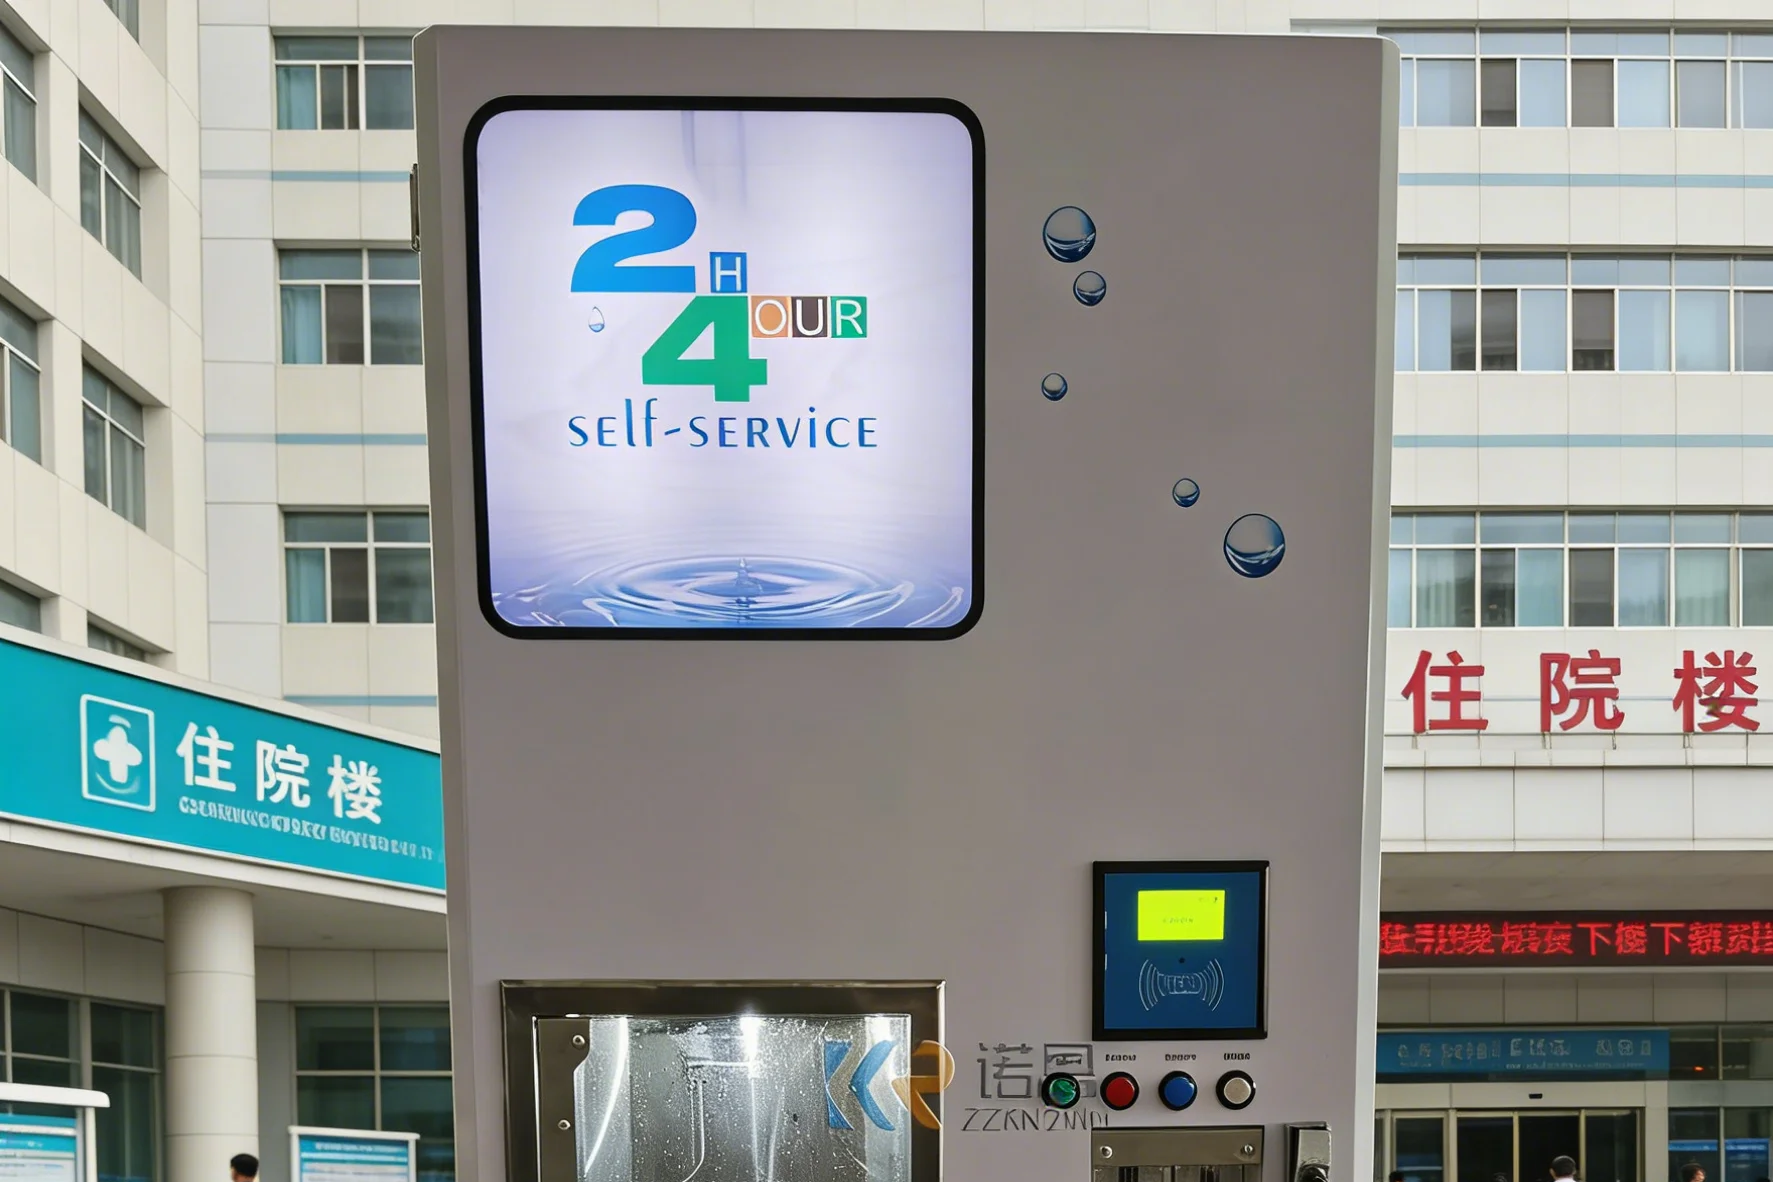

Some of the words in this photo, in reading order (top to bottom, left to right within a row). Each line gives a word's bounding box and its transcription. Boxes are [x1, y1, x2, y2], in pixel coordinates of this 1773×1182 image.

[1401, 649, 1760, 733] 住院楼
[176, 721, 382, 824] 住院楼
